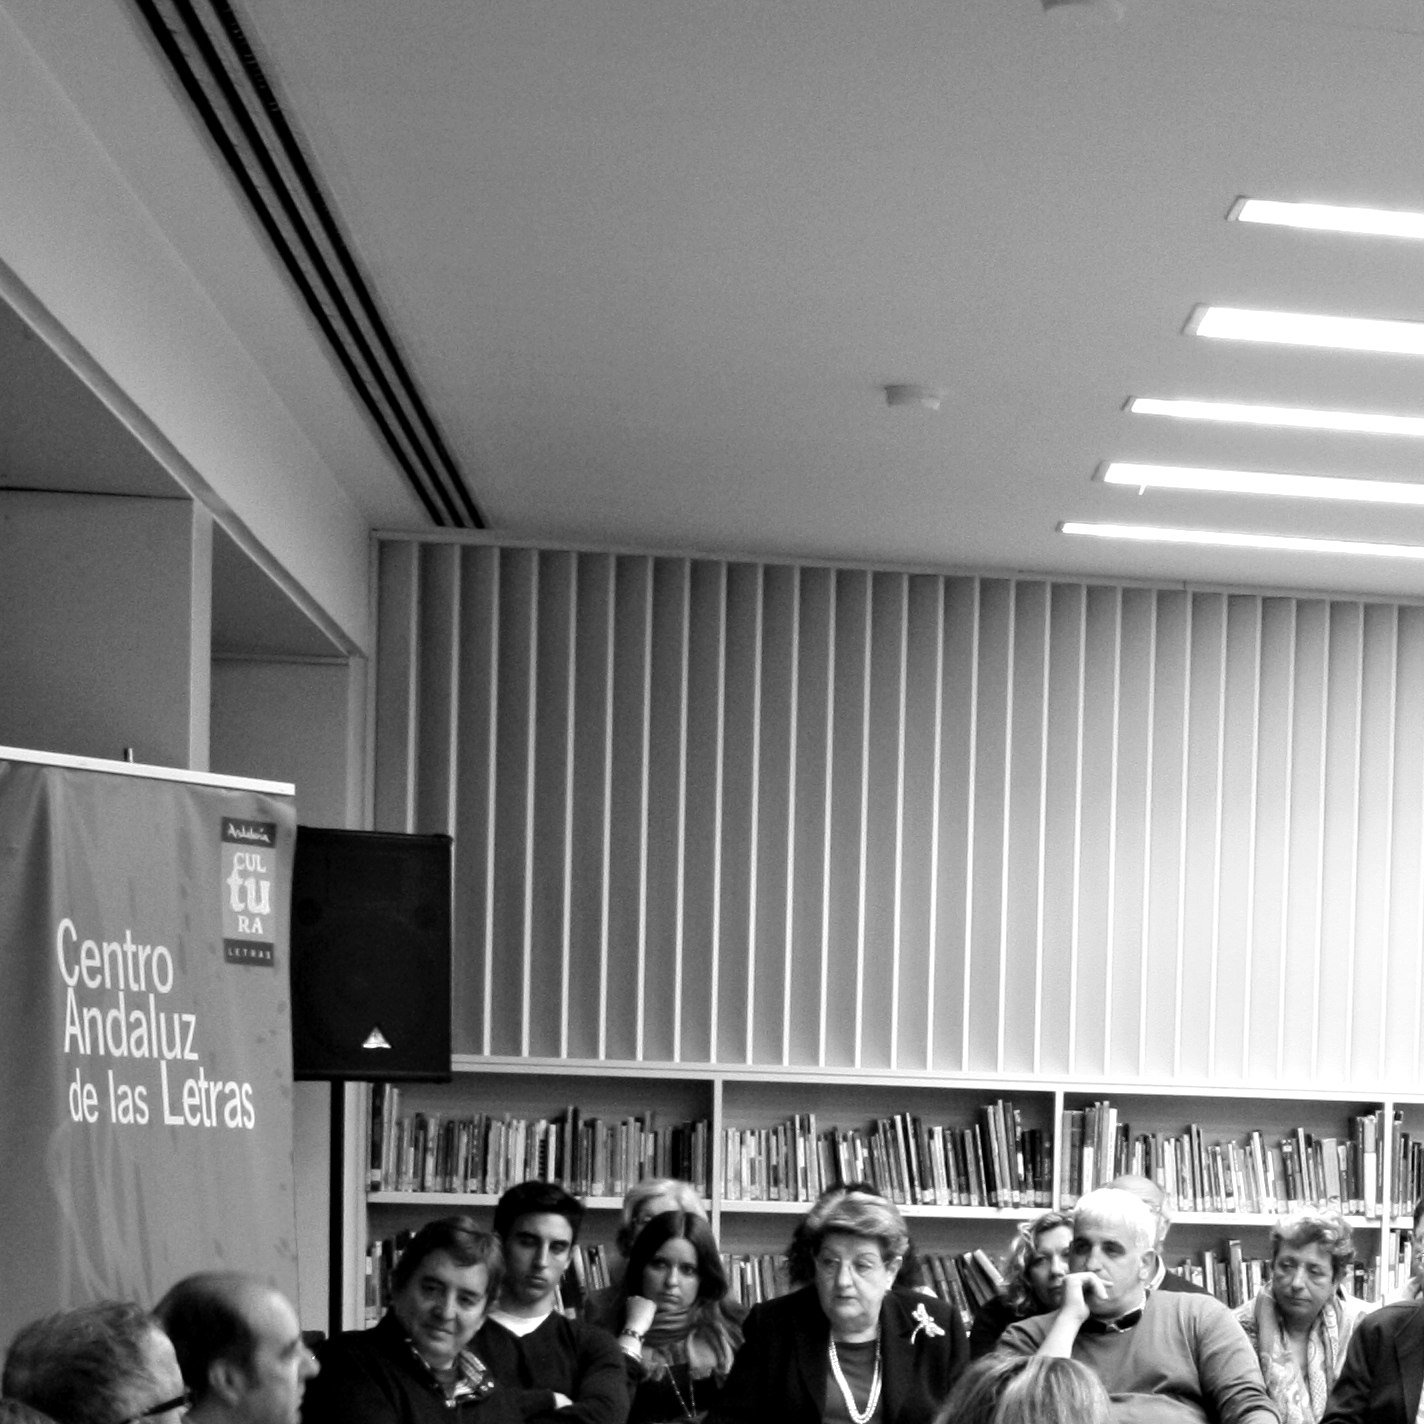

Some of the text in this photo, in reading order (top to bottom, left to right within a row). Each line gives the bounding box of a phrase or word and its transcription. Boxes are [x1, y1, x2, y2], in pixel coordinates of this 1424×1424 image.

[233, 852, 267, 873] CUL
[226, 869, 271, 915] tu
[237, 915, 264, 934] RA
[57, 918, 173, 994] Centro
[64, 987, 199, 1060] Andaluz
[69, 1060, 255, 1130] de las Letras
